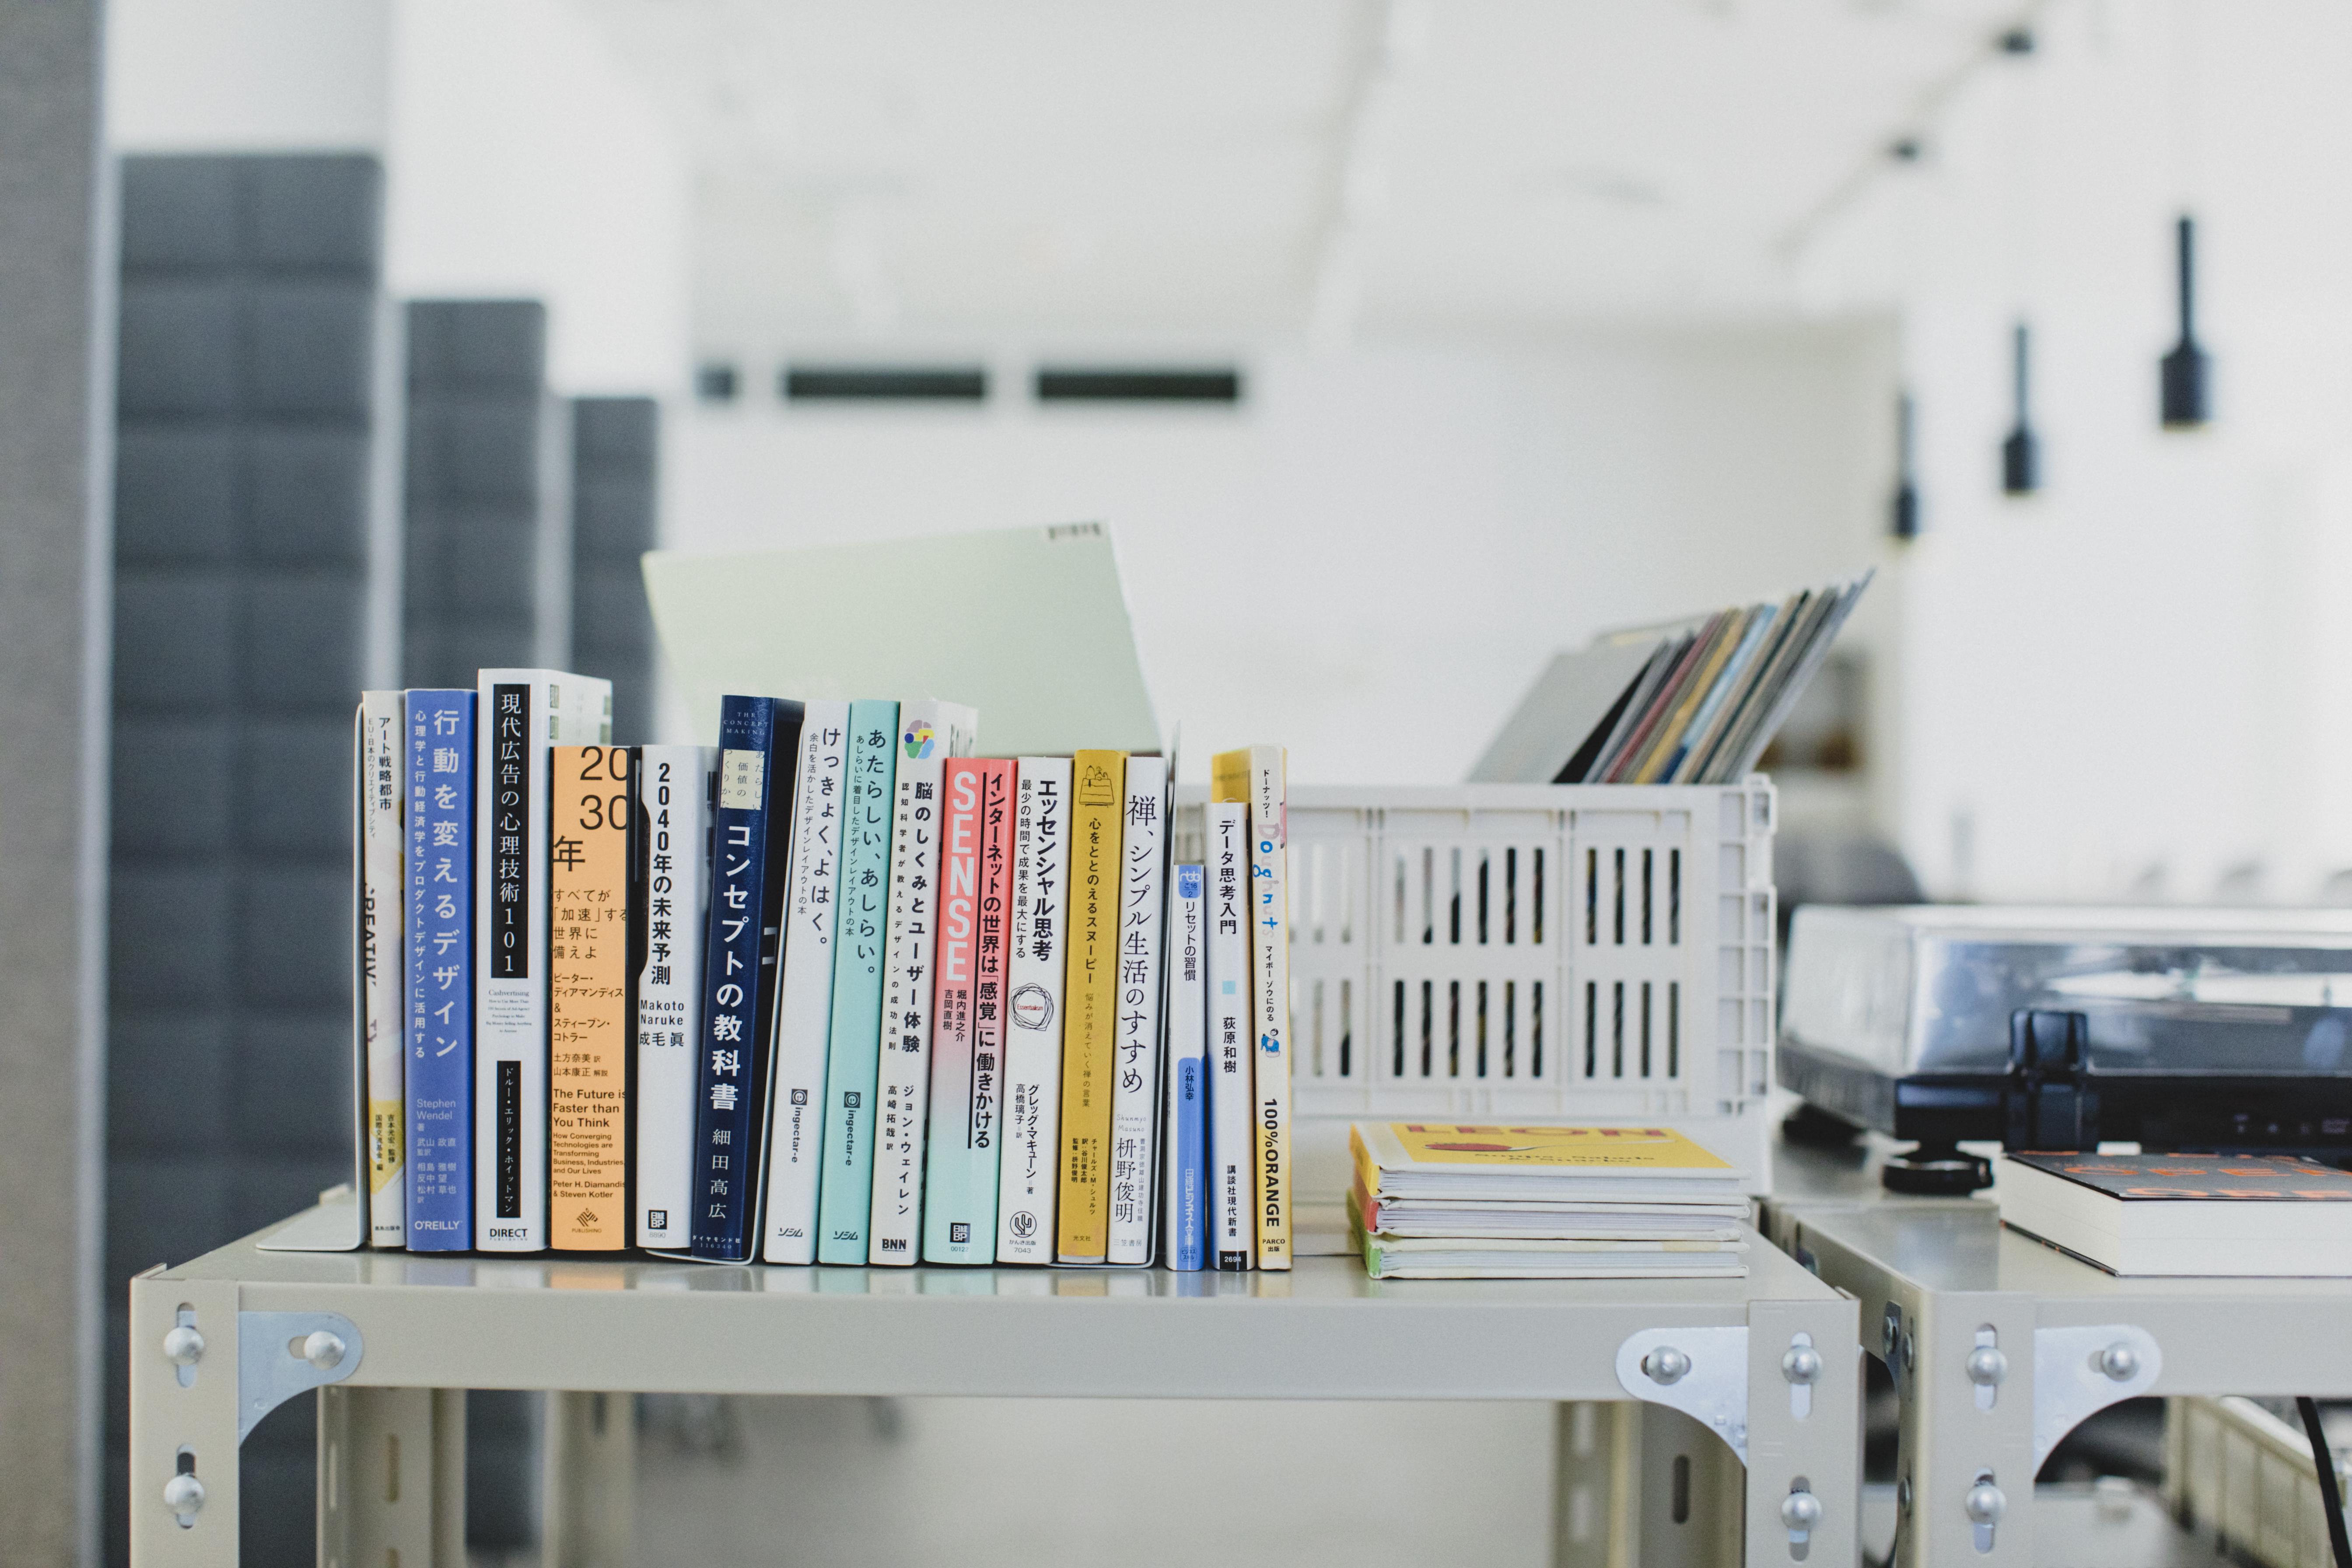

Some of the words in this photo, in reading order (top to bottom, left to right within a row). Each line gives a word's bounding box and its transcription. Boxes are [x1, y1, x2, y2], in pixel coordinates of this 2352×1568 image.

[379, 718, 392, 810] アート戦略都市
[579, 746, 627, 780] 20
[737, 762, 748, 797] 価値の
[579, 795, 627, 830] 30
[798, 733, 819, 915] 余白を活かしたデザインレイアウトの本
[499, 694, 521, 972] 現代広告の心理技術101
[812, 728, 841, 944] けっきょく、よはく。
[845, 735, 864, 936] あしらいに着目したデザインレイアウトの本
[553, 835, 586, 872] 年
[858, 729, 886, 973] あたらしい、あしらい。
[414, 710, 426, 1059] 心理学と行動経済学をプロダクトデザインに活用する
[433, 709, 459, 1057] 行動を変えるデザイン
[651, 763, 672, 986] 2040年の未来予測
[946, 771, 976, 981] SENSE
[1016, 779, 1032, 959] 最少の時間で成果を最大にする
[1032, 780, 1058, 962] エッセンシャル思考
[1219, 819, 1237, 934] データ思考入門
[1253, 822, 1280, 938] Doughnuts
[554, 890, 611, 902] すべてが
[1085, 818, 1101, 984] 心をととのえるスヌーピー
[554, 908, 627, 922] 「加速」する
[889, 783, 909, 1050] 認知科学者が教えるデザインの成功法則
[903, 782, 933, 1053] 脳のしくみとユーザー体験
[554, 927, 598, 941] 世界に
[1120, 794, 1157, 1093] 禅、シンプル生活のすすめ
[1183, 902, 1196, 981] リセットの習慣
[553, 945, 596, 959] 備えよ
[710, 826, 751, 1111] コンセプトの教科書
[975, 774, 1006, 1148] インターネットの世界は「感覚」に働きかける
[554, 973, 593, 983] ピーター・
[554, 987, 623, 998] ディアマンディス
[554, 1003, 560, 1012] &
[554, 1018, 609, 1028] スティーブン・
[640, 1000, 685, 1011] Makoto
[640, 1015, 684, 1026] Naruke
[943, 990, 953, 1031] 吉岡直樹
[956, 990, 967, 1042] 堀内進之介
[554, 1033, 588, 1042] コトラー
[639, 1032, 665, 1046] 成毛
[1082, 993, 1094, 1108] 悩みが消えていく禅の言葉
[1223, 1017, 1236, 1073] 荻原和樹
[554, 1053, 591, 1063] 土方奈美
[554, 1067, 591, 1077] 山本康正
[553, 1089, 573, 1098] The
[577, 1089, 614, 1099] Future
[619, 1089, 625, 1099] is
[1185, 1066, 1194, 1101] 小林弘幸
[417, 1099, 456, 1110] Stephen
[417, 1110, 452, 1120] Wendel
[553, 1103, 588, 1113] Faster
[593, 1104, 619, 1113] than
[553, 1117, 573, 1127] You
[578, 1118, 609, 1127] Think
[1116, 1114, 1147, 1124] Shunmyo
[417, 1138, 434, 1147] 武山
[438, 1138, 456, 1147] 政直
[504, 1068, 514, 1212] ドルー・エリック・ホイットマン
[791, 1107, 803, 1162] ingectar-e
[846, 1110, 856, 1166] ingectar-e
[1406, 1125, 1666, 1137] LEON
[417, 1162, 434, 1172] 相島
[898, 1085, 914, 1215] ジョン・ウェイレン
[1264, 1099, 1280, 1227] 100%ORANGE
[417, 1174, 435, 1183] 反中
[438, 1174, 447, 1183] 望
[417, 1185, 435, 1194] 松村
[708, 1129, 731, 1219] 細田高広
[1114, 1138, 1137, 1223] 枡野俊明
[1227, 1165, 1237, 1237] 講談社現代新書
[490, 1228, 528, 1237] DIRECT
[651, 1219, 665, 1228] BP
[693, 1235, 740, 1243] ダイヤモンド社
[778, 1227, 803, 1237] ソシム
[833, 1231, 858, 1240] ソシム
[953, 1232, 967, 1241] BP
[882, 1239, 906, 1250] BNN
